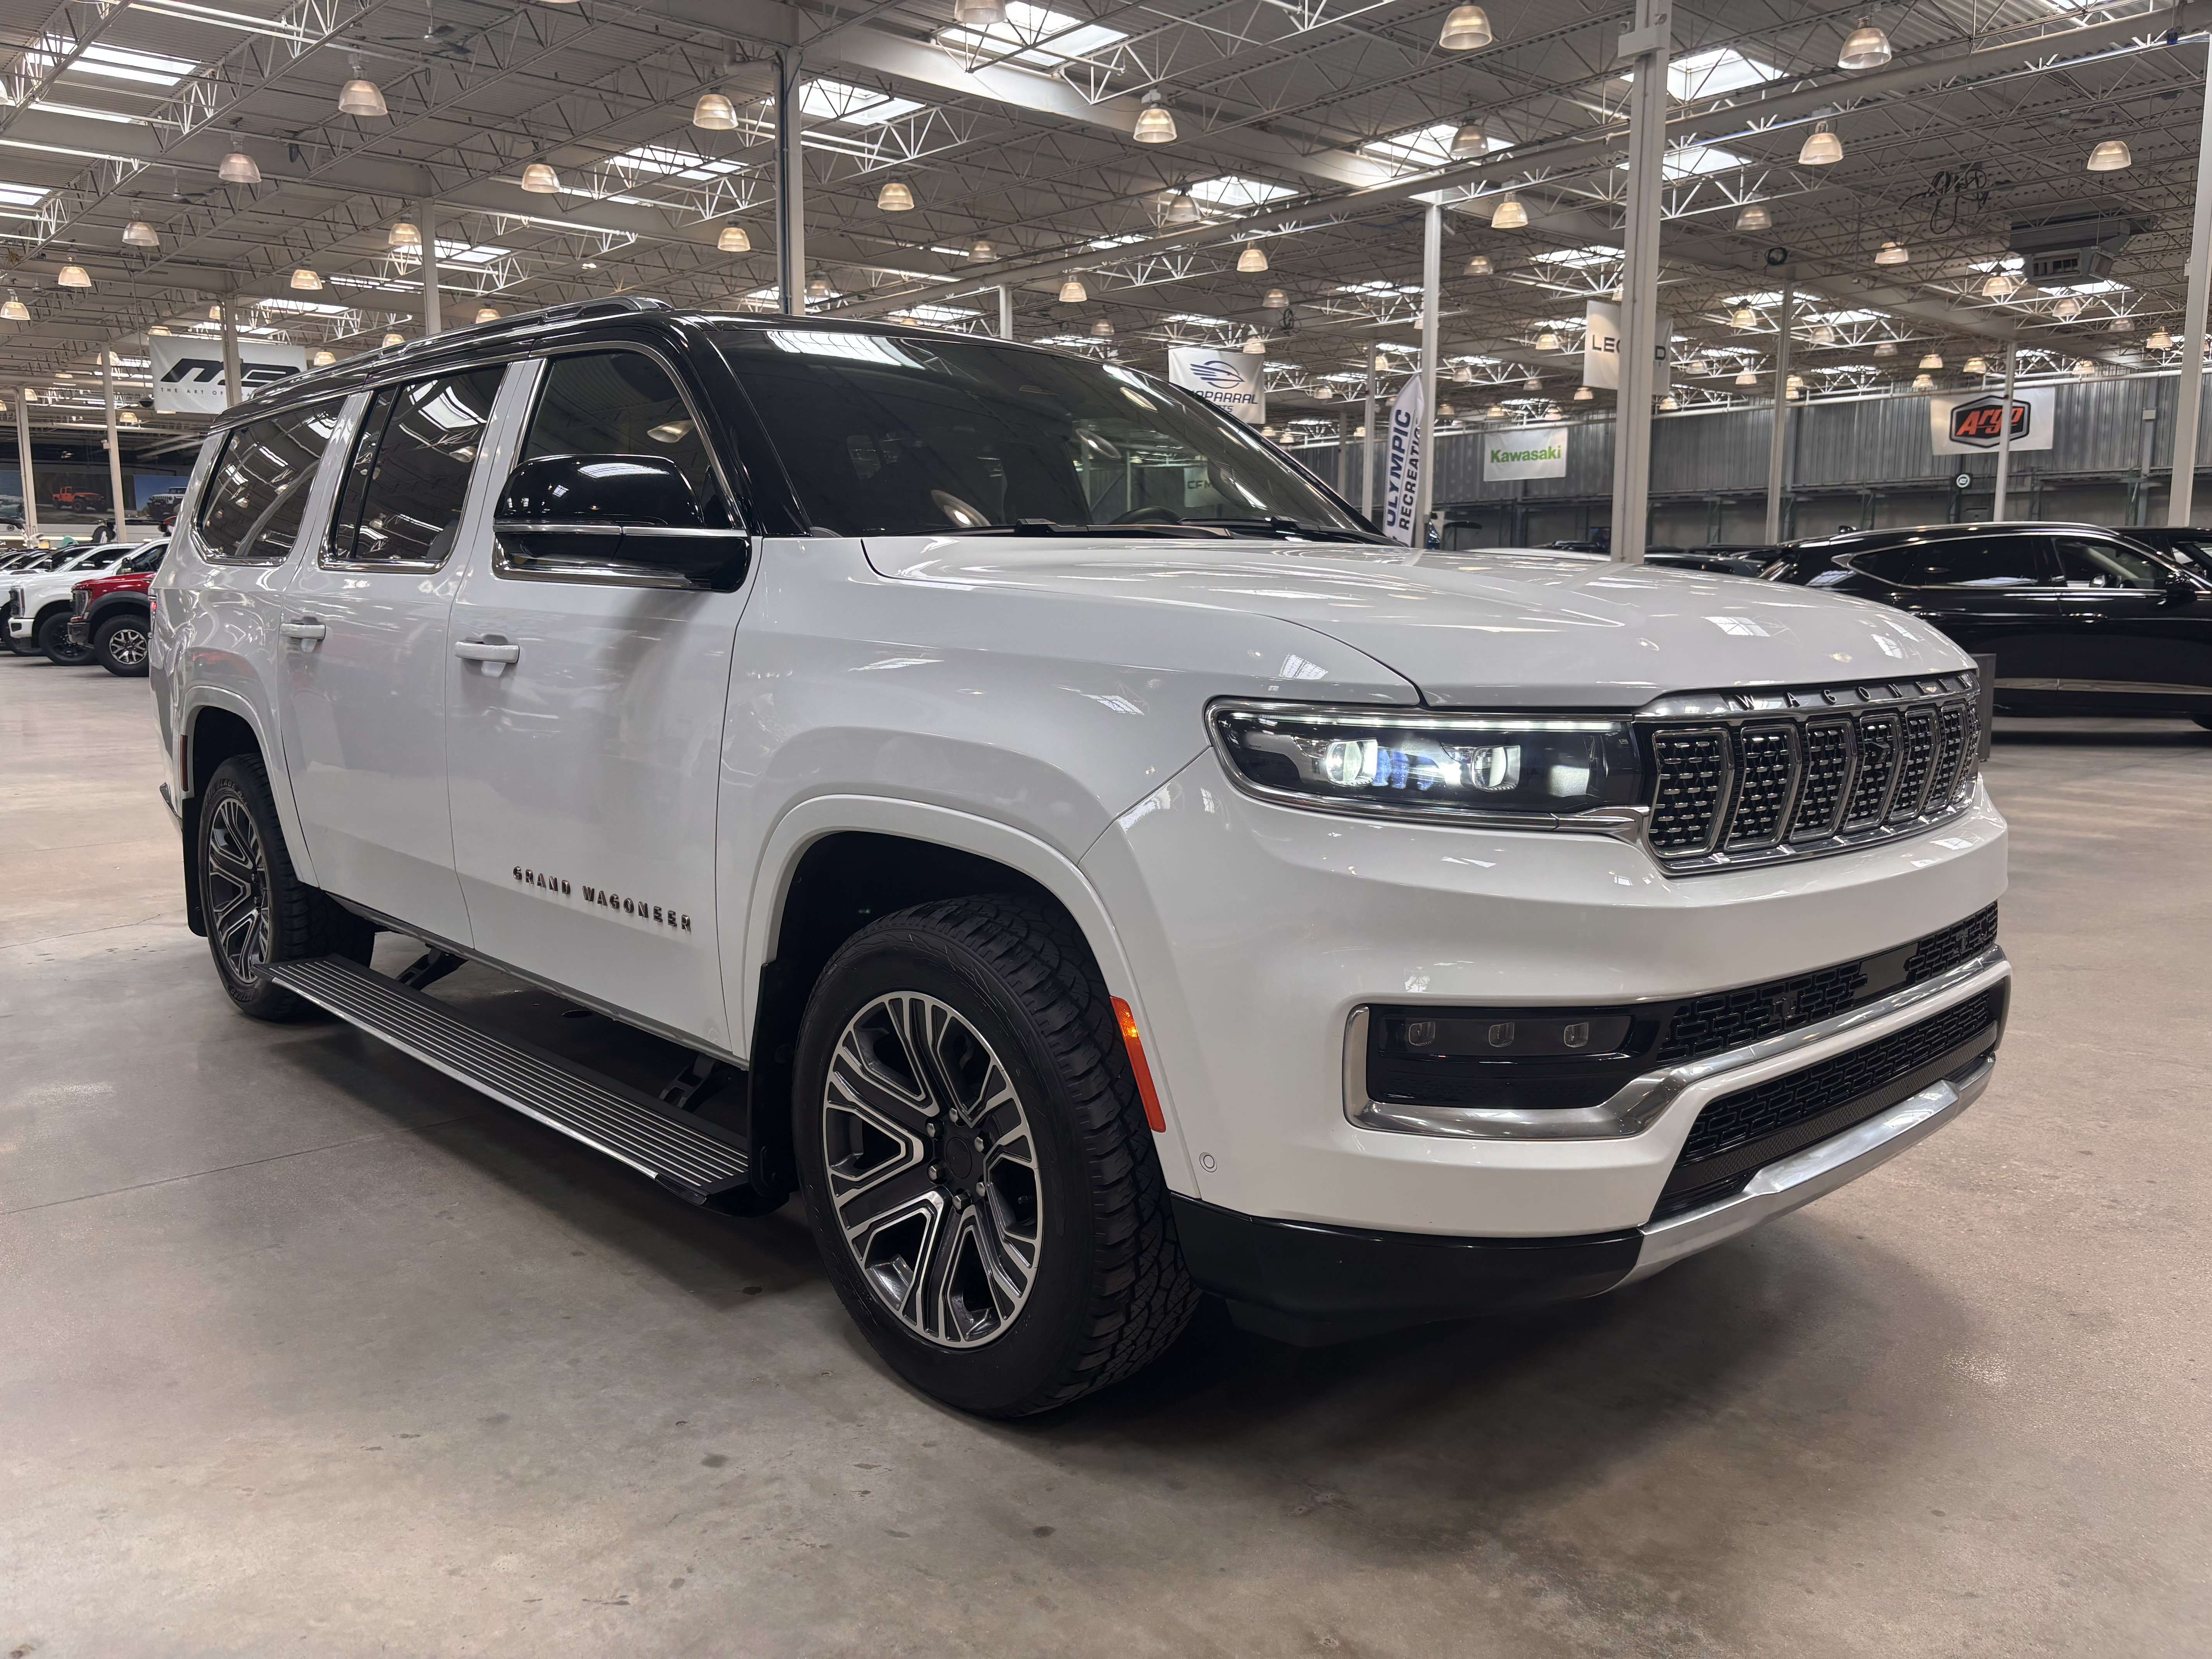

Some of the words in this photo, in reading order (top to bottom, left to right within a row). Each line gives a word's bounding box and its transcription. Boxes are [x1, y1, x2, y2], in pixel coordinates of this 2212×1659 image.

[1592, 334, 1666, 361] LED
[1192, 390, 1259, 404] APARRAL
[1956, 408, 2024, 436] Argo
[1491, 446, 1561, 463] Kawasaki
[513, 866, 571, 895] GRAND
[582, 885, 692, 932] WAGONEER
